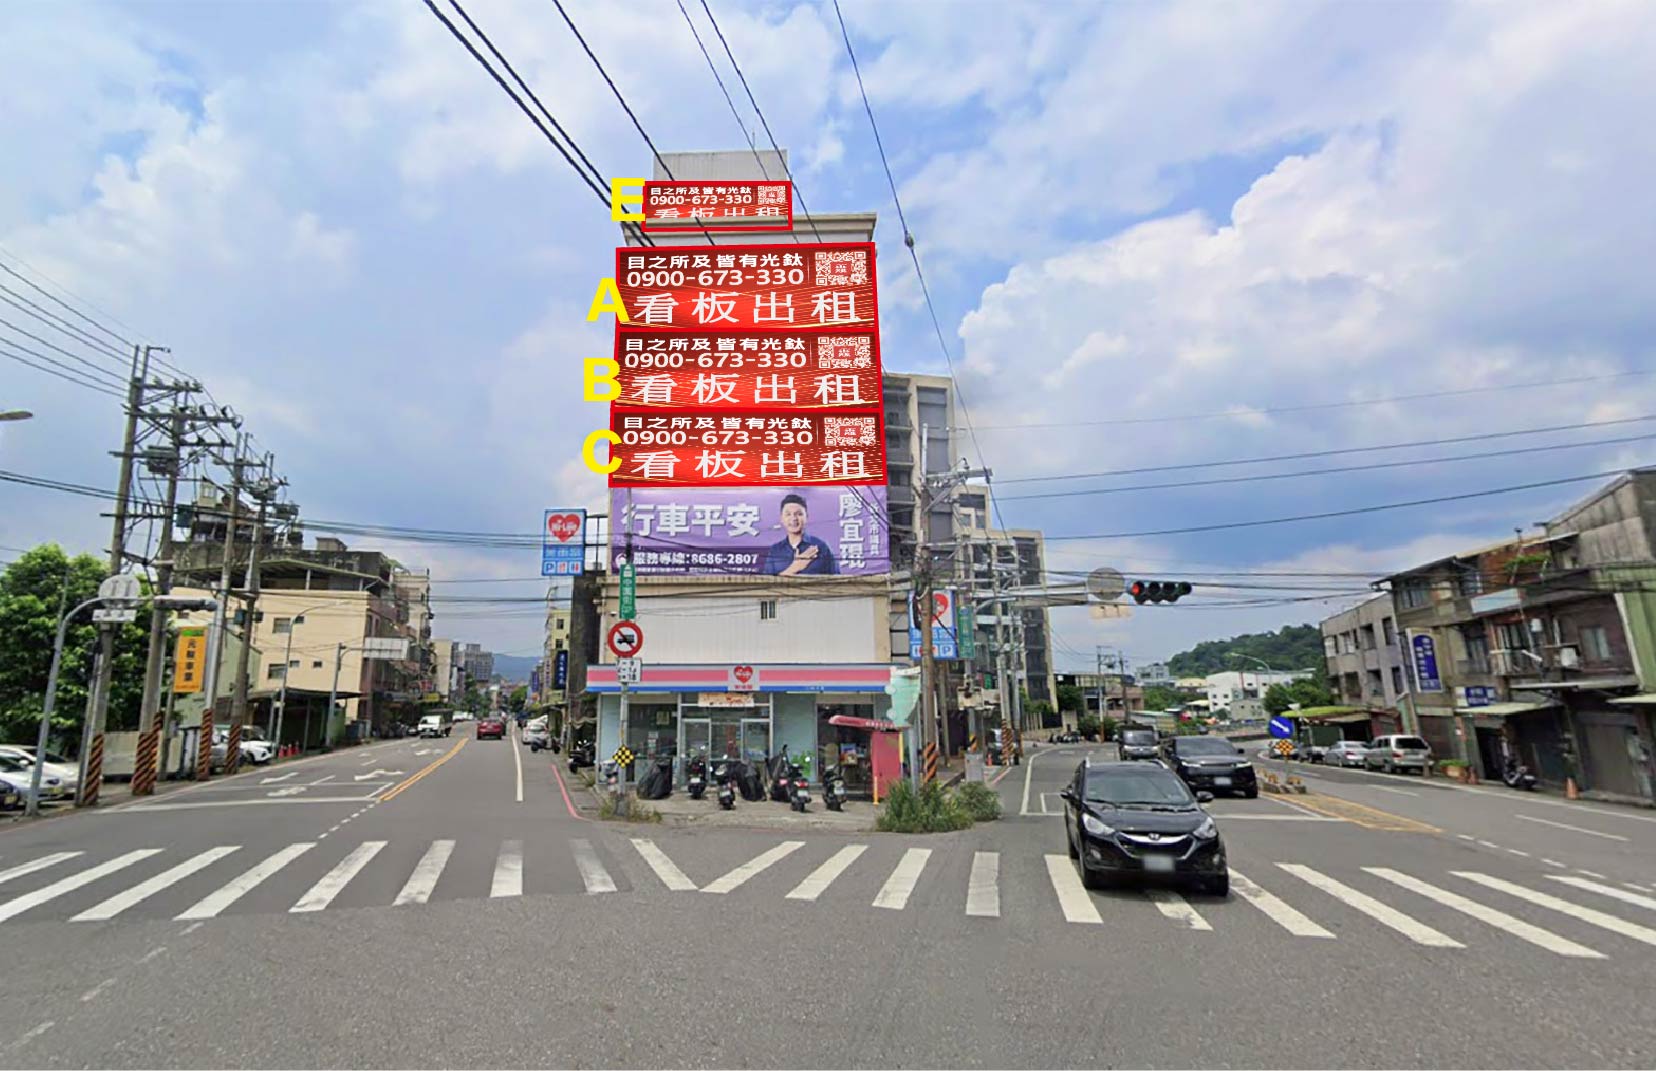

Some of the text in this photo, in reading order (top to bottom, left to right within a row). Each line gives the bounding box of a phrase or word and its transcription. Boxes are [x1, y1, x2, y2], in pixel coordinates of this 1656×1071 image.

[650, 195, 752, 205] 0900-673-330
[627, 269, 804, 286] 0900-673-330
[634, 291, 861, 324] 看板出租
[624, 352, 807, 368] 0900-673-330
[631, 373, 865, 404] 看板出租
[622, 430, 813, 445] 0900-673-330
[630, 450, 870, 479] 看板出租
[621, 502, 760, 537] 行車平安
